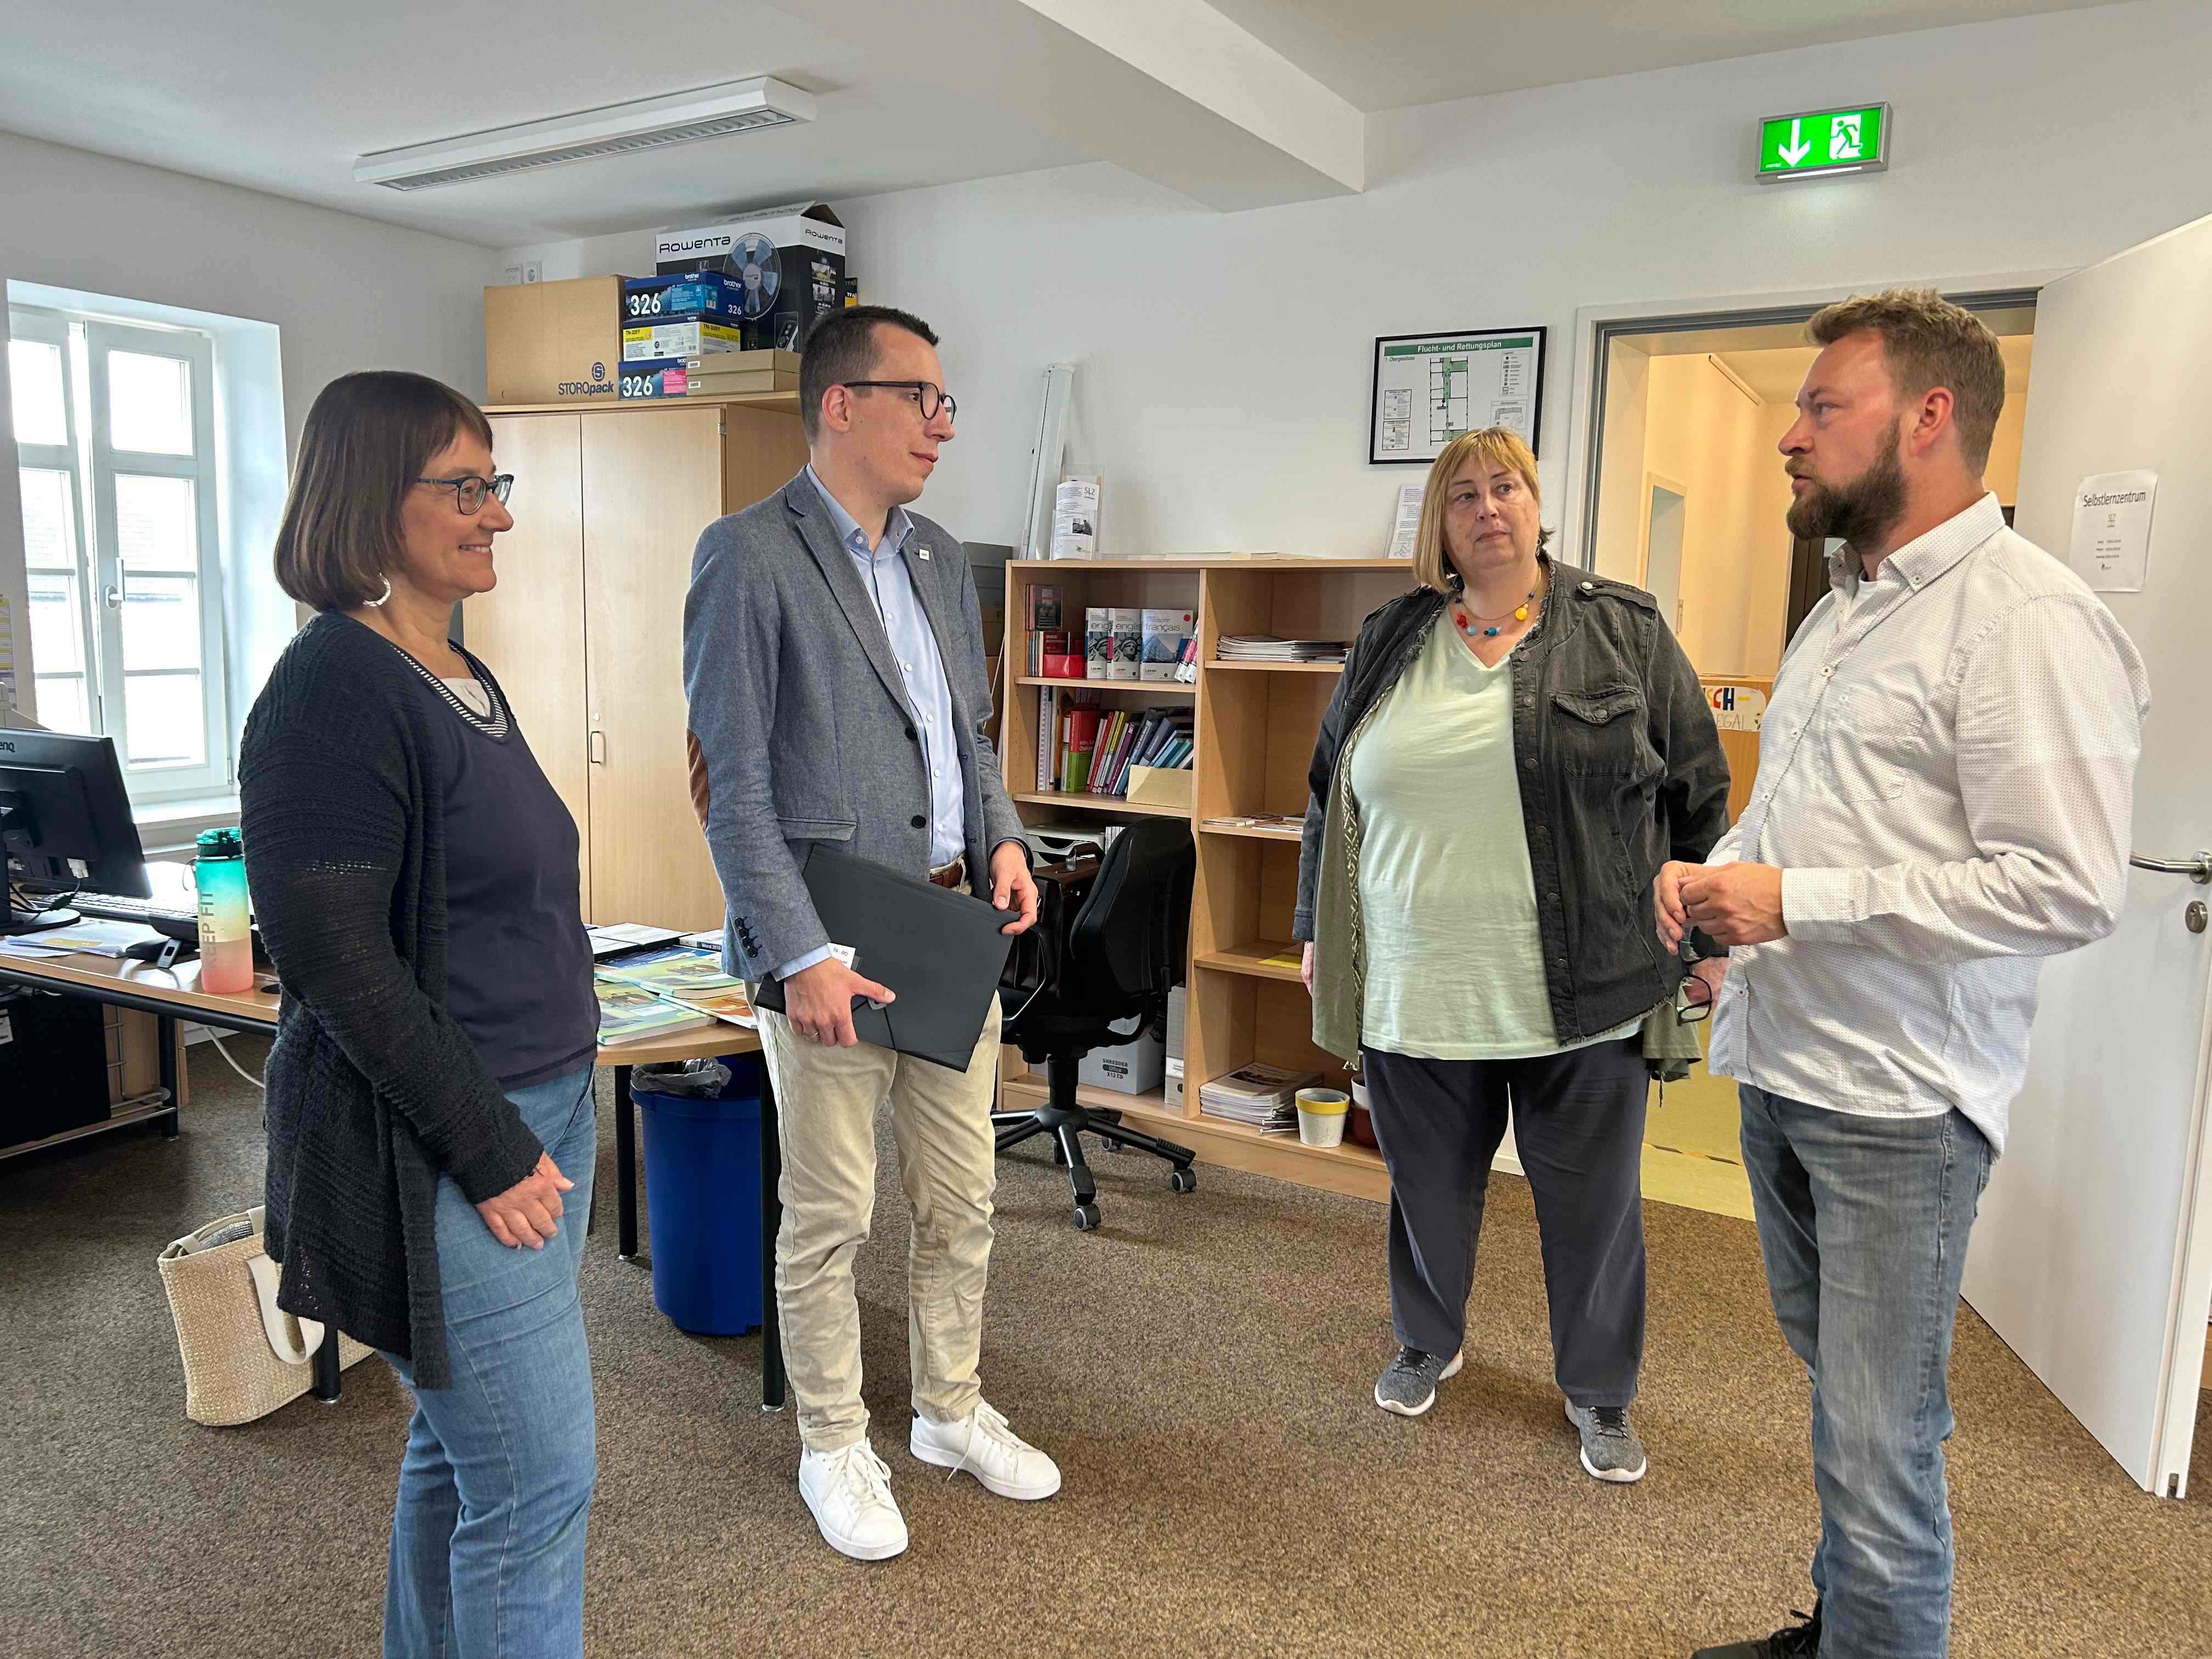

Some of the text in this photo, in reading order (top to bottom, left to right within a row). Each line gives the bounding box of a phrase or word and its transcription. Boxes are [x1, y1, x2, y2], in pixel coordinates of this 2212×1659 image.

[630, 293, 661, 315] 326
[728, 304, 742, 315] 326
[1418, 345, 1441, 353] Flucht-
[1457, 341, 1502, 350] Rettungsplan
[558, 381, 614, 396] STOROpack
[623, 375, 653, 397] 326
[2084, 492, 2146, 507] Selbstlernzentrum
[1115, 623, 1142, 631] englis
[1146, 623, 1181, 632] français
